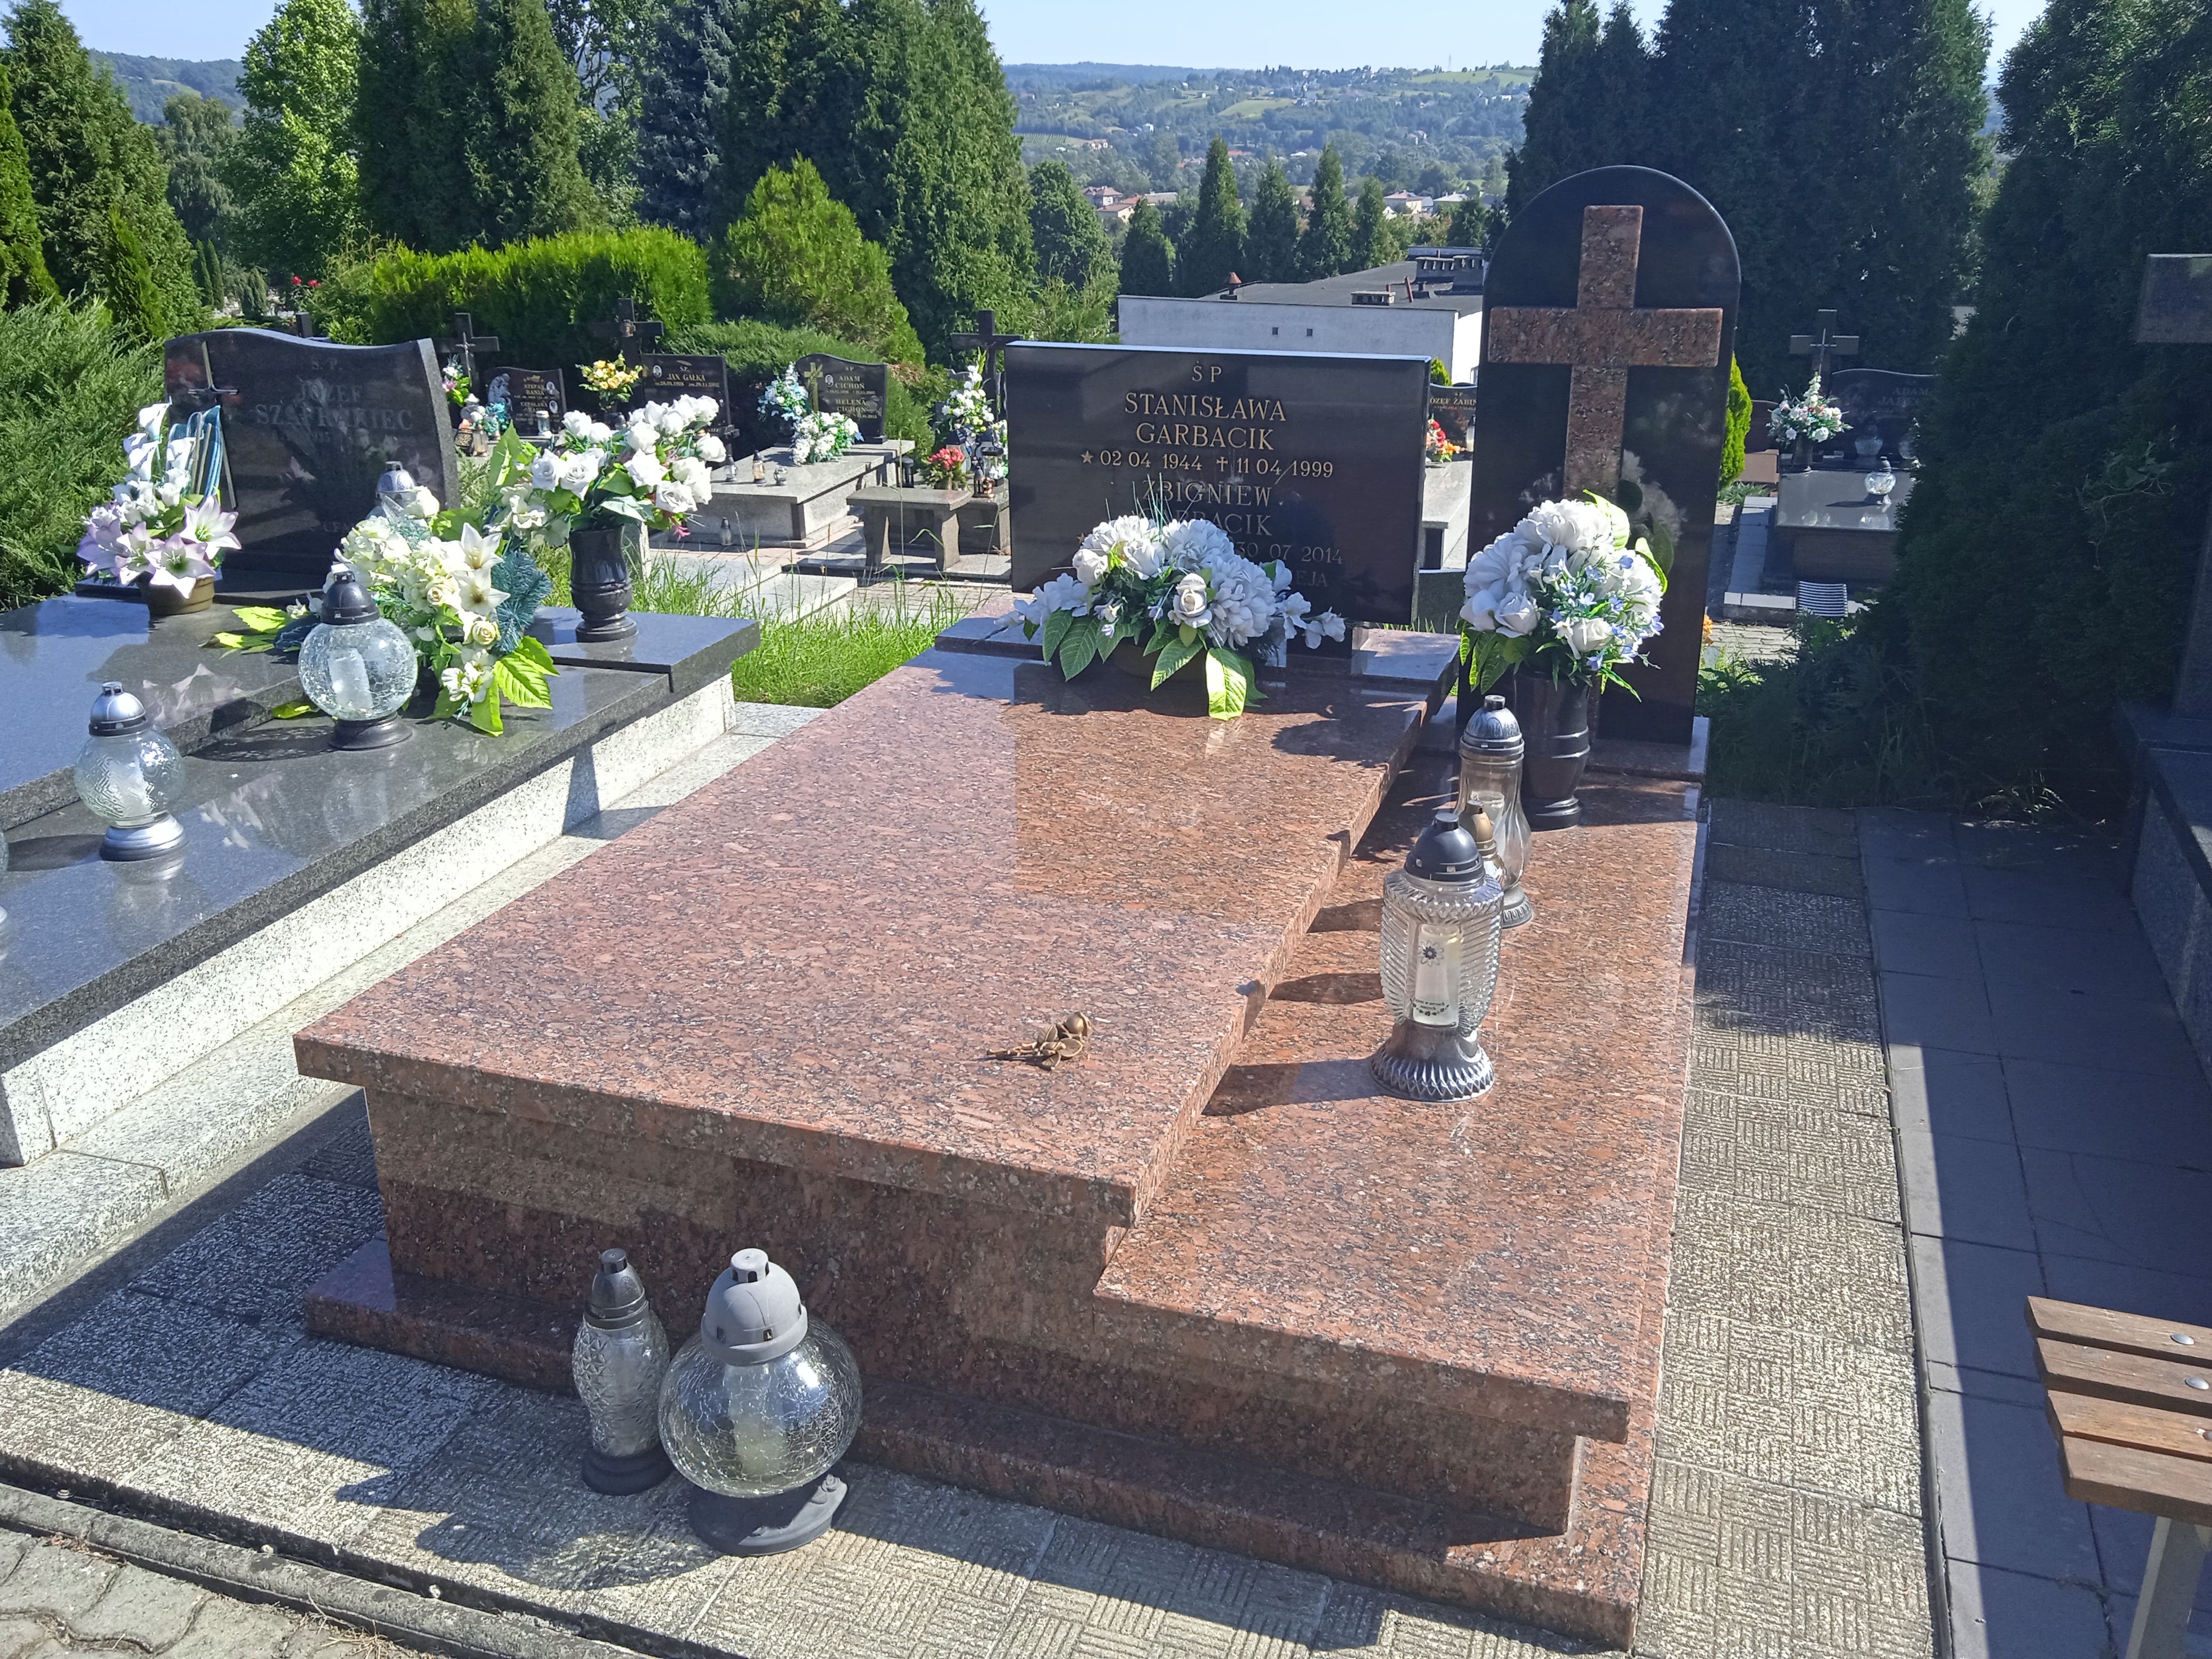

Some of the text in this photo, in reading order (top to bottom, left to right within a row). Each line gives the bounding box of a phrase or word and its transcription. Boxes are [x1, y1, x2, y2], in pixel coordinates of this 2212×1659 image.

[1210, 366, 1222, 382] P
[1125, 392, 1286, 421] STANISŁAWA
[1136, 423, 1274, 450] GARBACIK
[1100, 450, 1334, 478] 02 04 1944 11 04 1999
[1142, 480, 1272, 507] ZBIGNIEW
[1139, 508, 1273, 536] ACIK
[1269, 543, 1292, 560] 07
[1302, 546, 1343, 564] 2014
